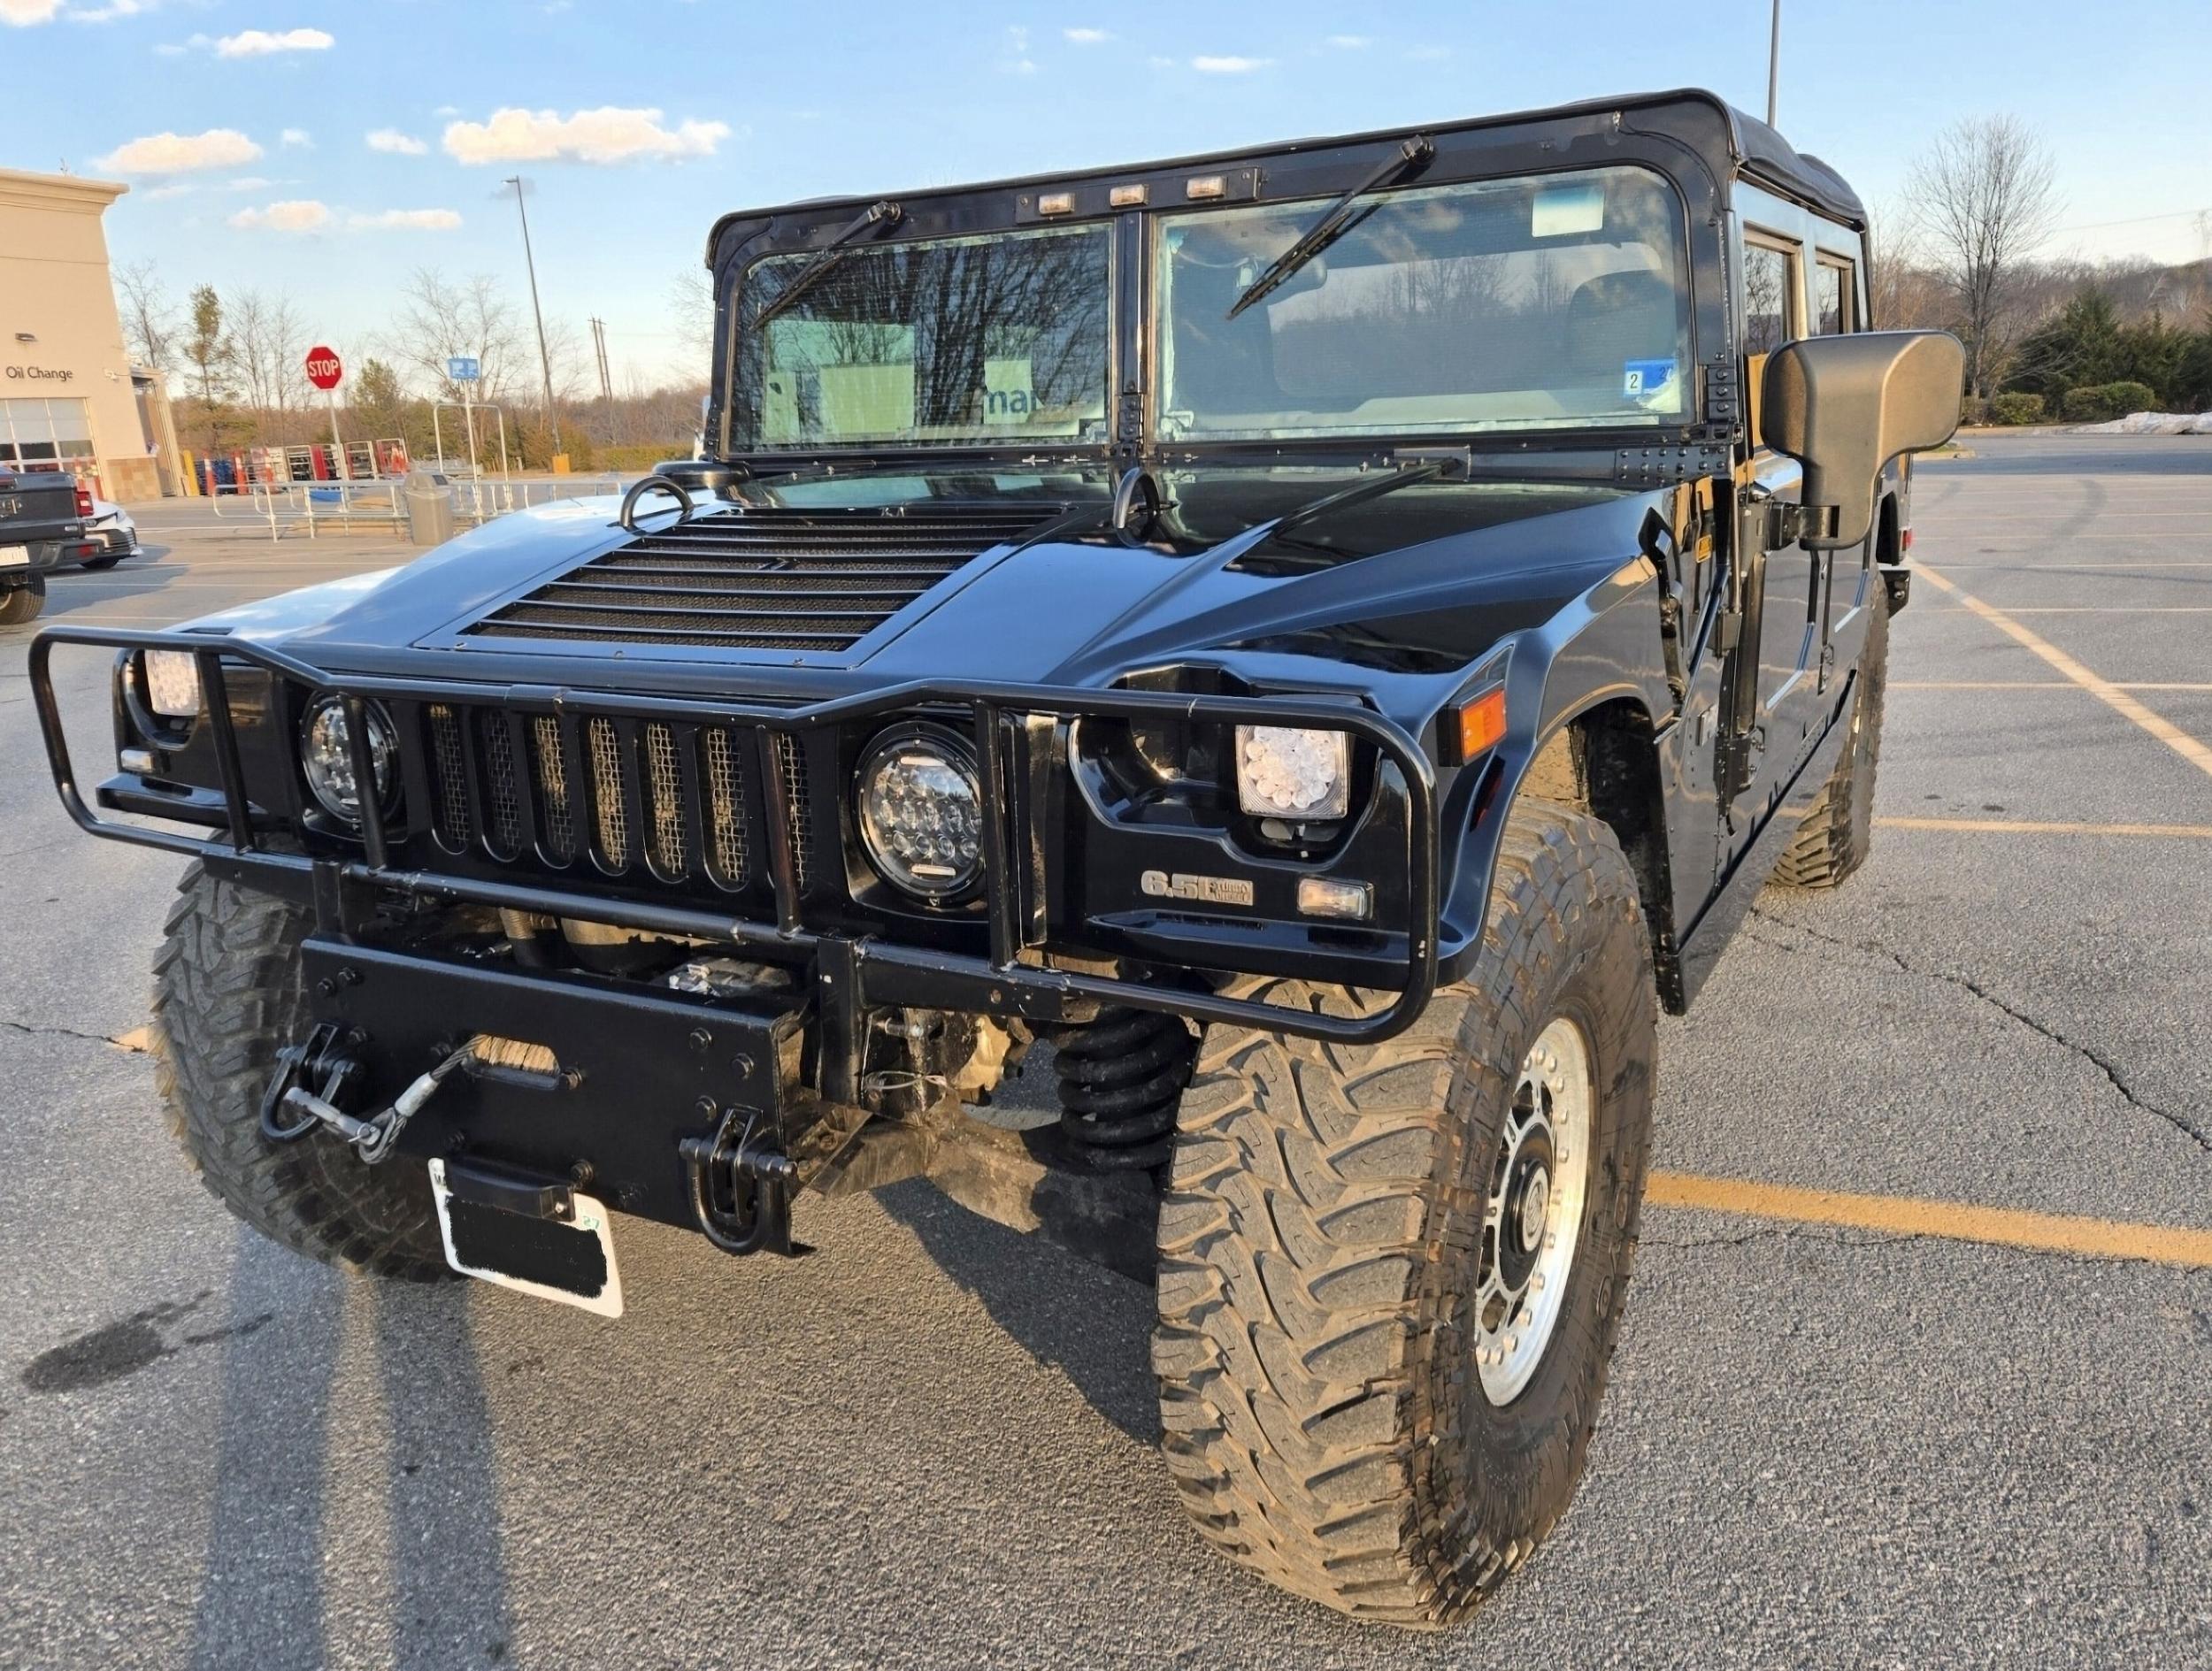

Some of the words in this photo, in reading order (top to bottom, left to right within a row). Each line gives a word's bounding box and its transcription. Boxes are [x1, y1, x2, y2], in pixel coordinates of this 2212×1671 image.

[5, 365, 25, 379] Oil
[27, 365, 73, 382] Change
[308, 360, 339, 378] STOP
[1630, 372, 1639, 389] 2
